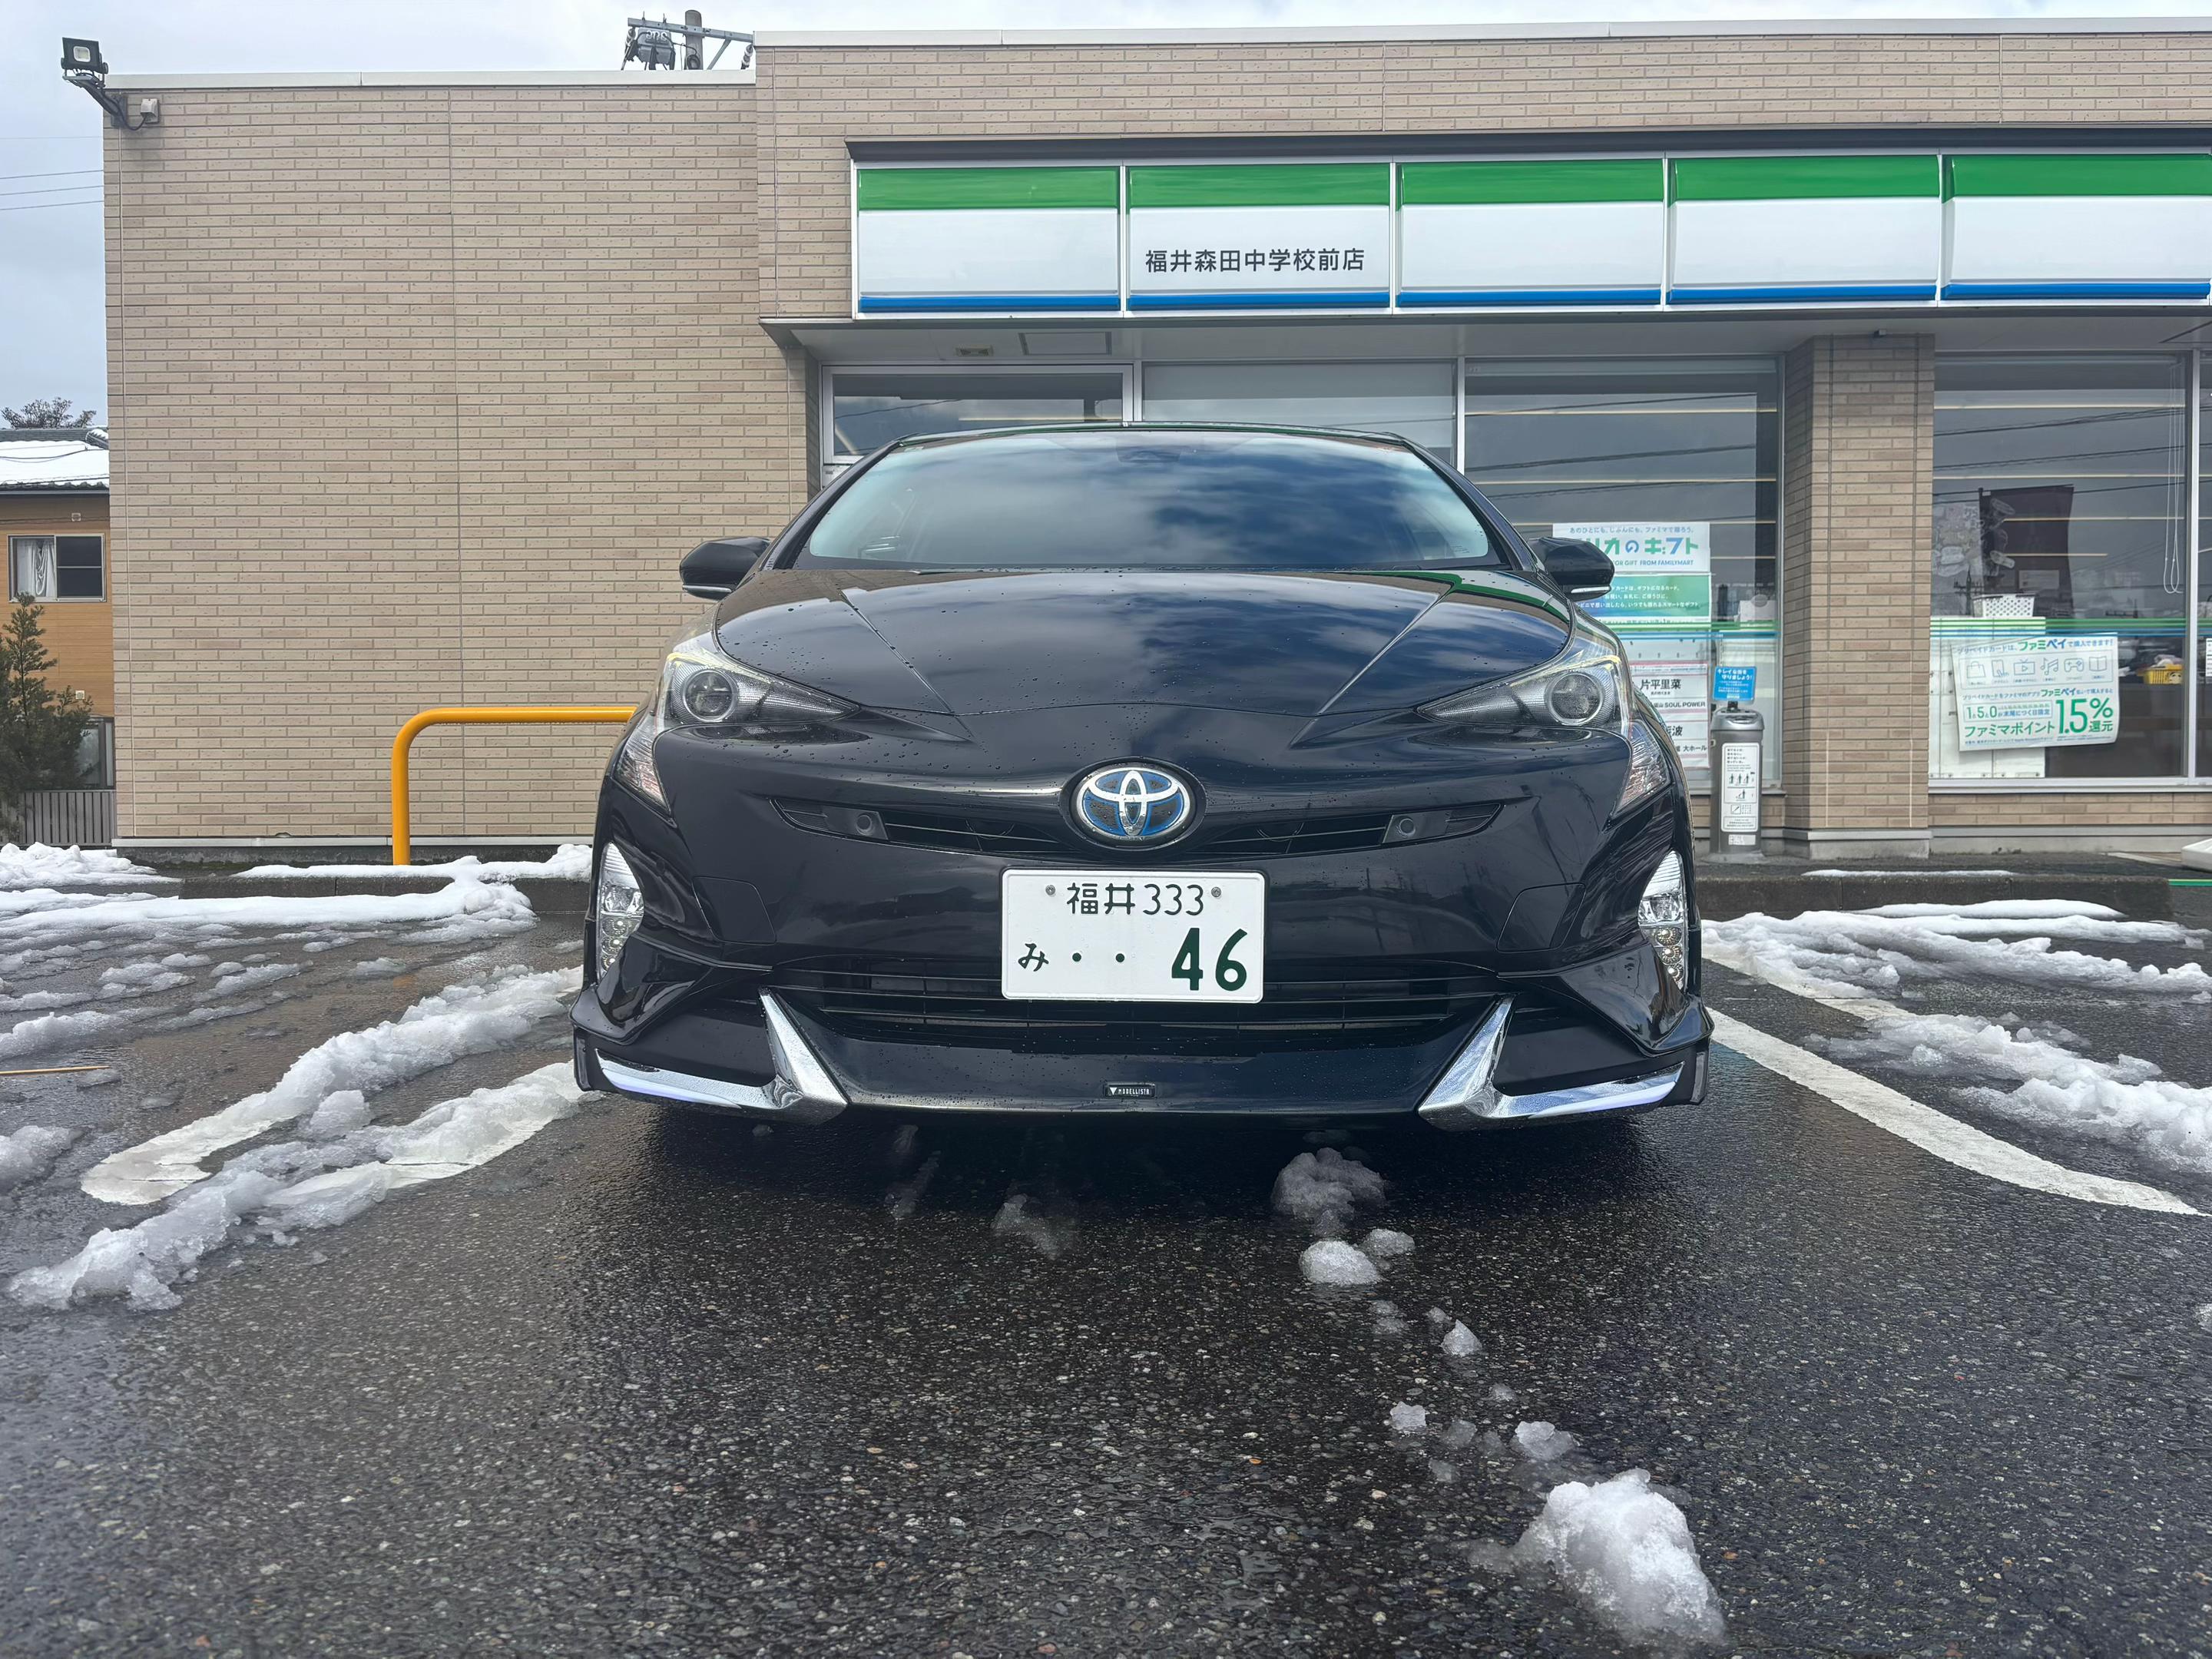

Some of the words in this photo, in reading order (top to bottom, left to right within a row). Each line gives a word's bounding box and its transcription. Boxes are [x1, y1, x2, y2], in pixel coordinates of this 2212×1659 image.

[1145, 248, 1365, 273] 福井森田中学校前店
[1640, 679, 1681, 690] 片平里菜
[1965, 720, 2055, 737] ファミマポイント
[2089, 720, 2114, 732] 還元
[1067, 882, 1135, 915] 福井
[1143, 884, 1204, 916] 333
[1018, 943, 1049, 972] み
[1171, 927, 1248, 992] 46
